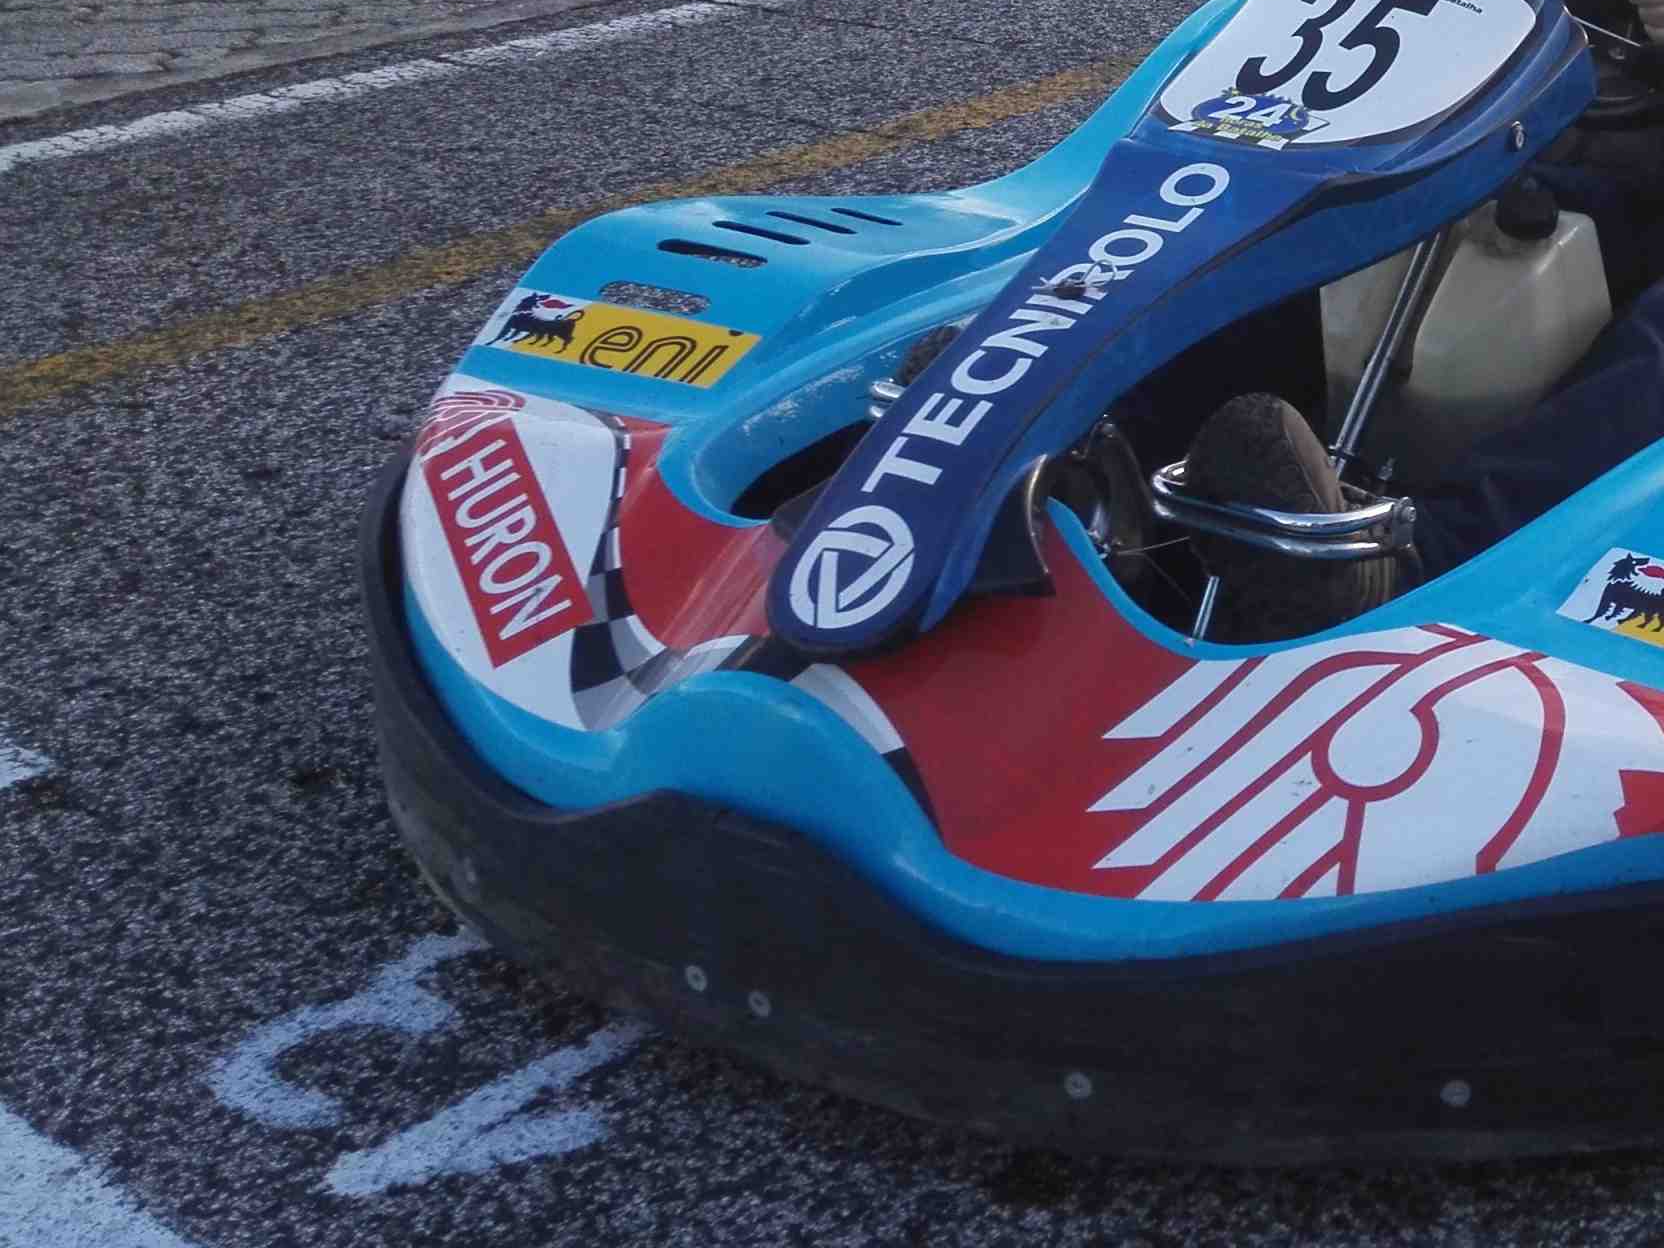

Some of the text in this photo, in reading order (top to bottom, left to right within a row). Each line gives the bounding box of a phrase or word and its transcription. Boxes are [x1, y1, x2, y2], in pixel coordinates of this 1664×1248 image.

[1207, 95, 1293, 128] 24
[580, 325, 745, 385] eni
[861, 163, 1230, 493] TECNIROLO
[440, 439, 572, 641] HURON
